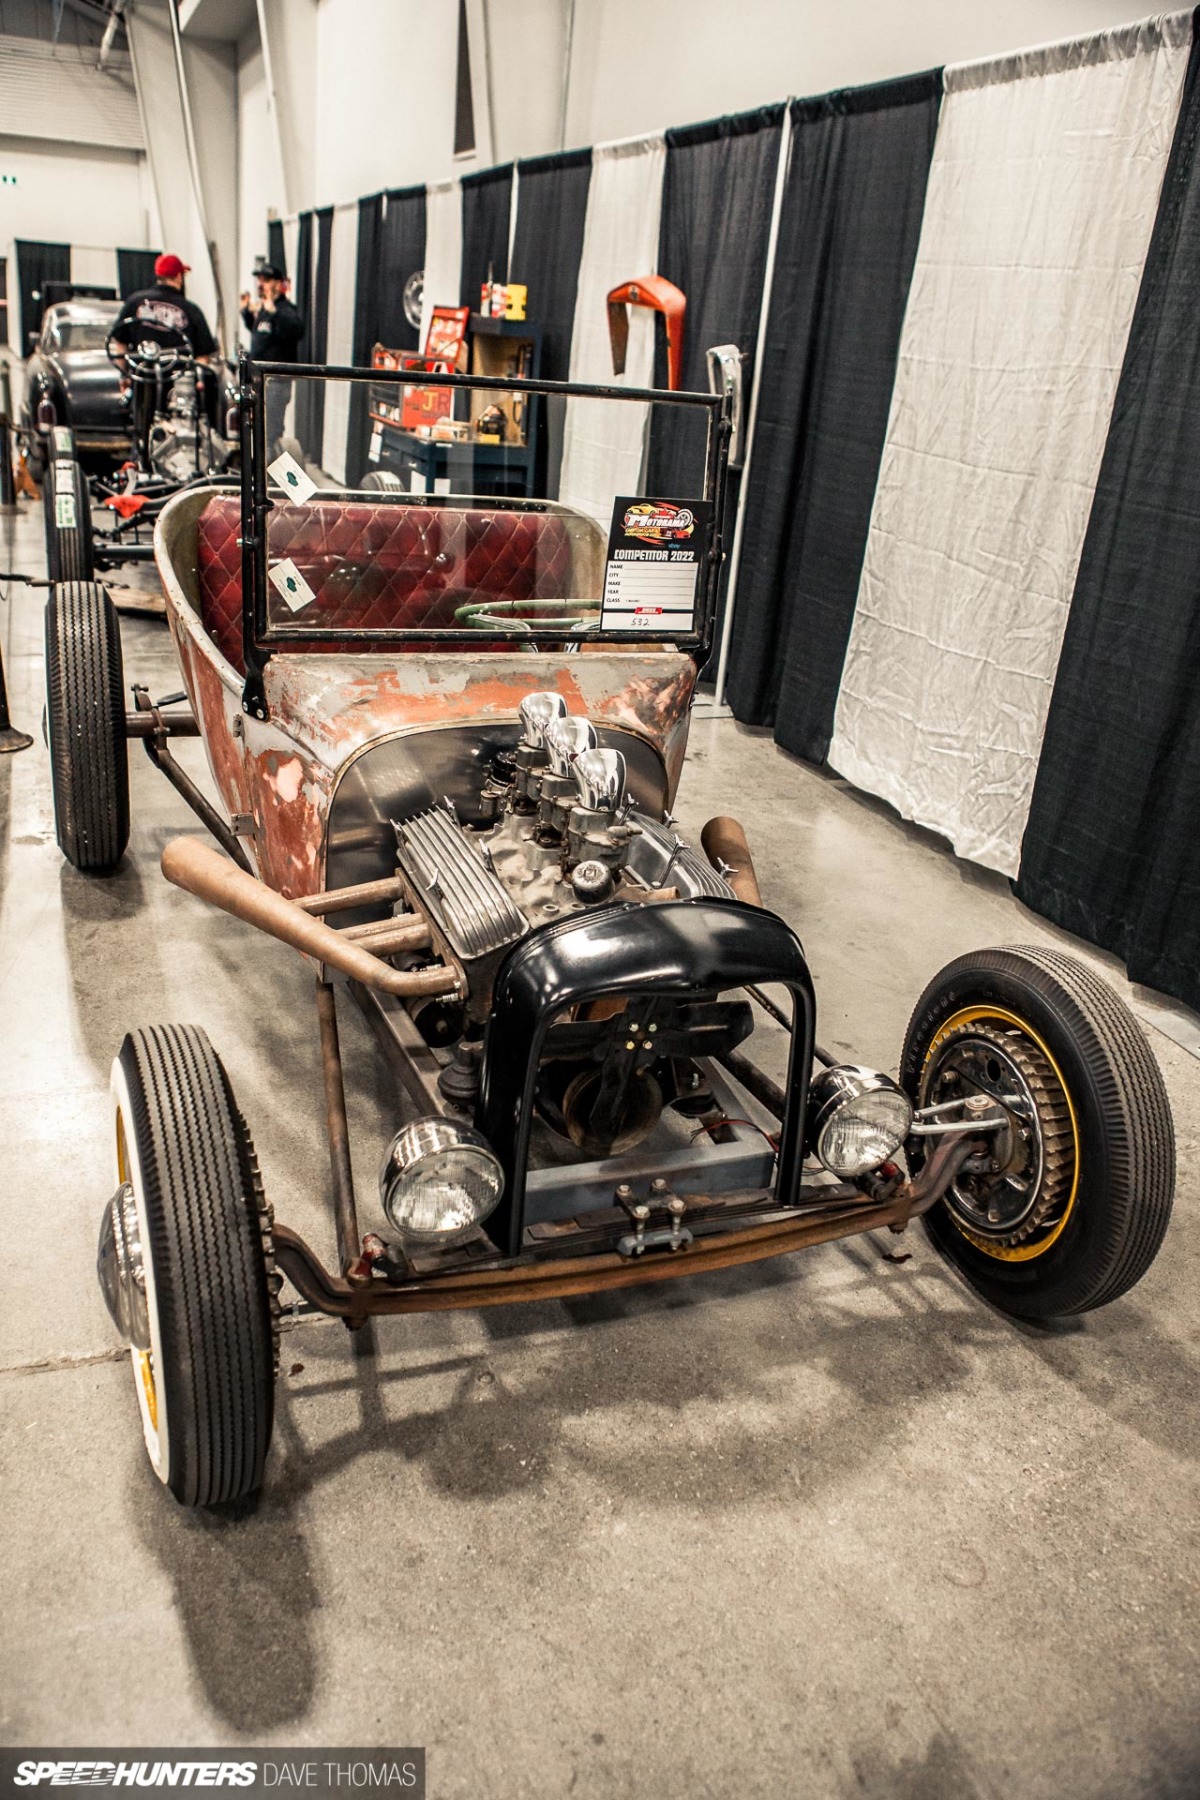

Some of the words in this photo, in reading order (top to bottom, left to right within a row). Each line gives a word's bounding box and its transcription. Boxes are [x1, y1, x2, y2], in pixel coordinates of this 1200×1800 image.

[614, 549, 669, 561] COMPETITOR
[670, 550, 695, 562] 2022
[631, 618, 650, 626] 532
